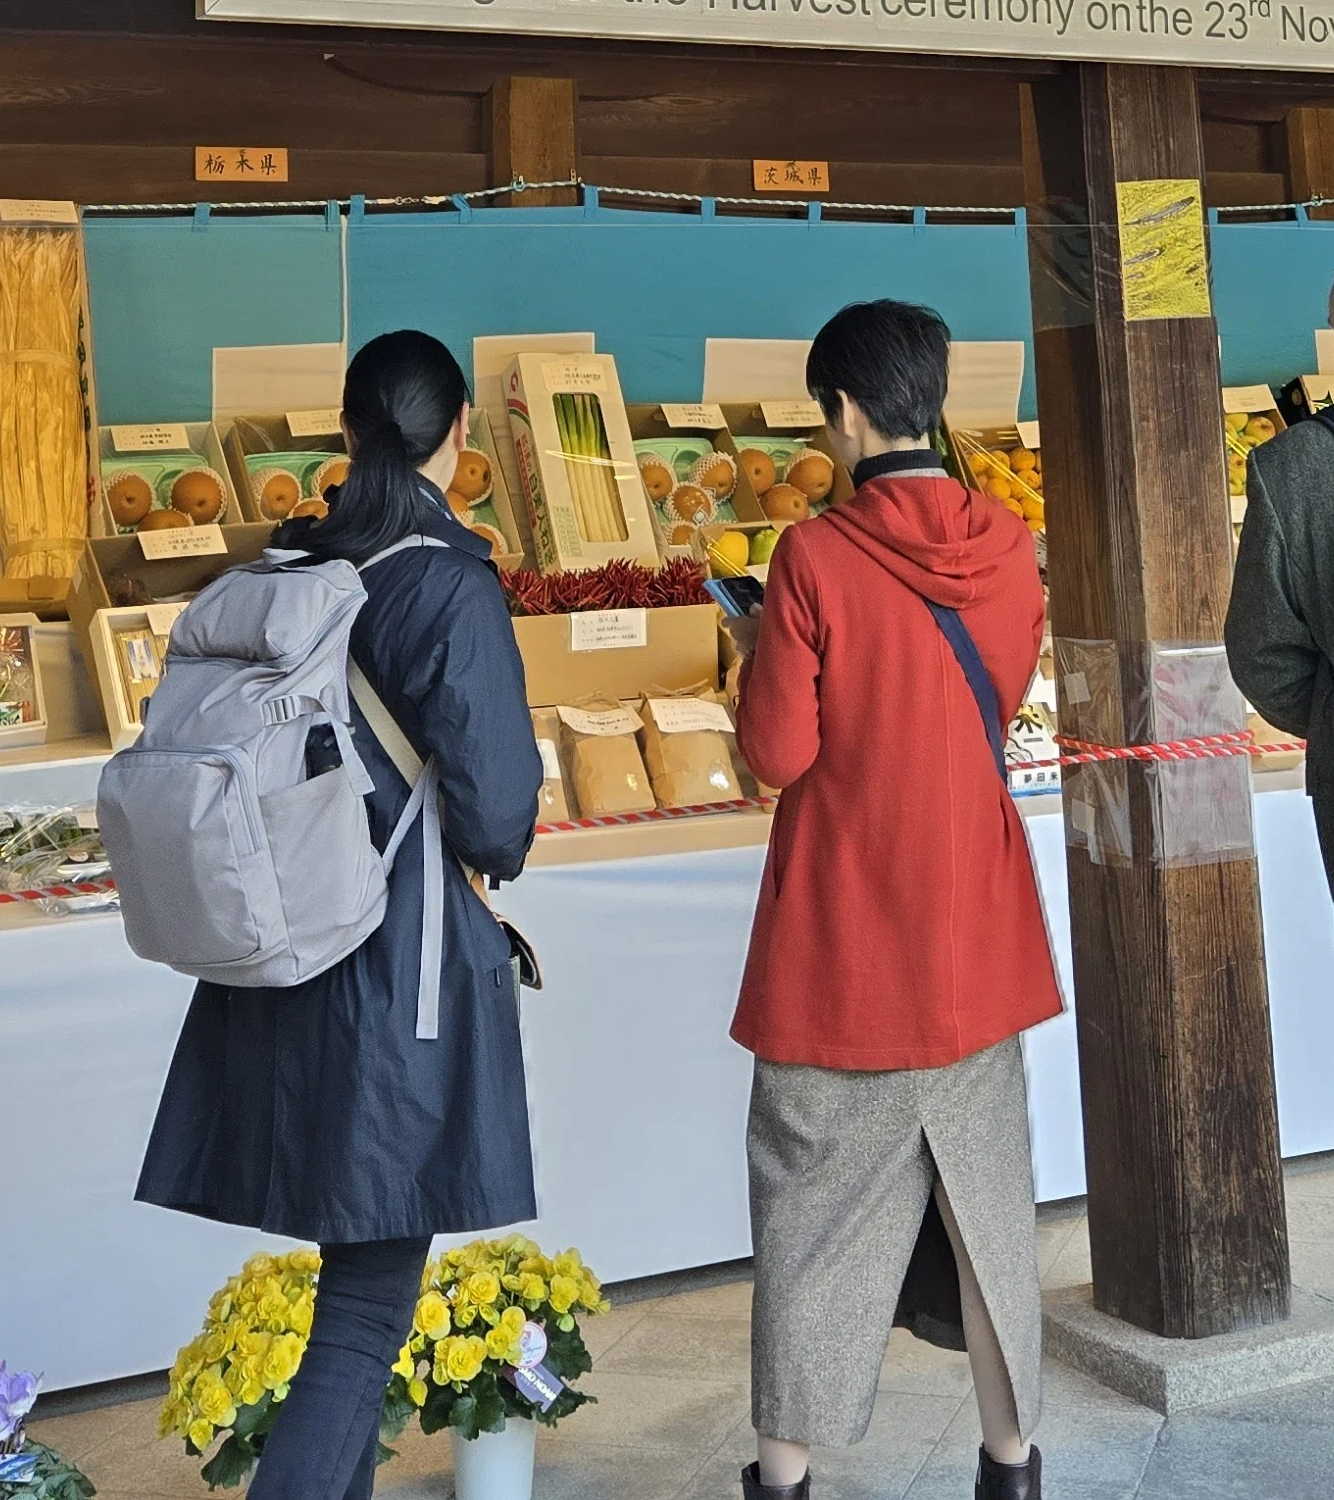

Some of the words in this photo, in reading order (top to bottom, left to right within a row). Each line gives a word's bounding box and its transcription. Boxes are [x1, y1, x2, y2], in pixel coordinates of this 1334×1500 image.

[204, 153, 277, 175] 栃木県
[764, 166, 822, 185] 茨城県
